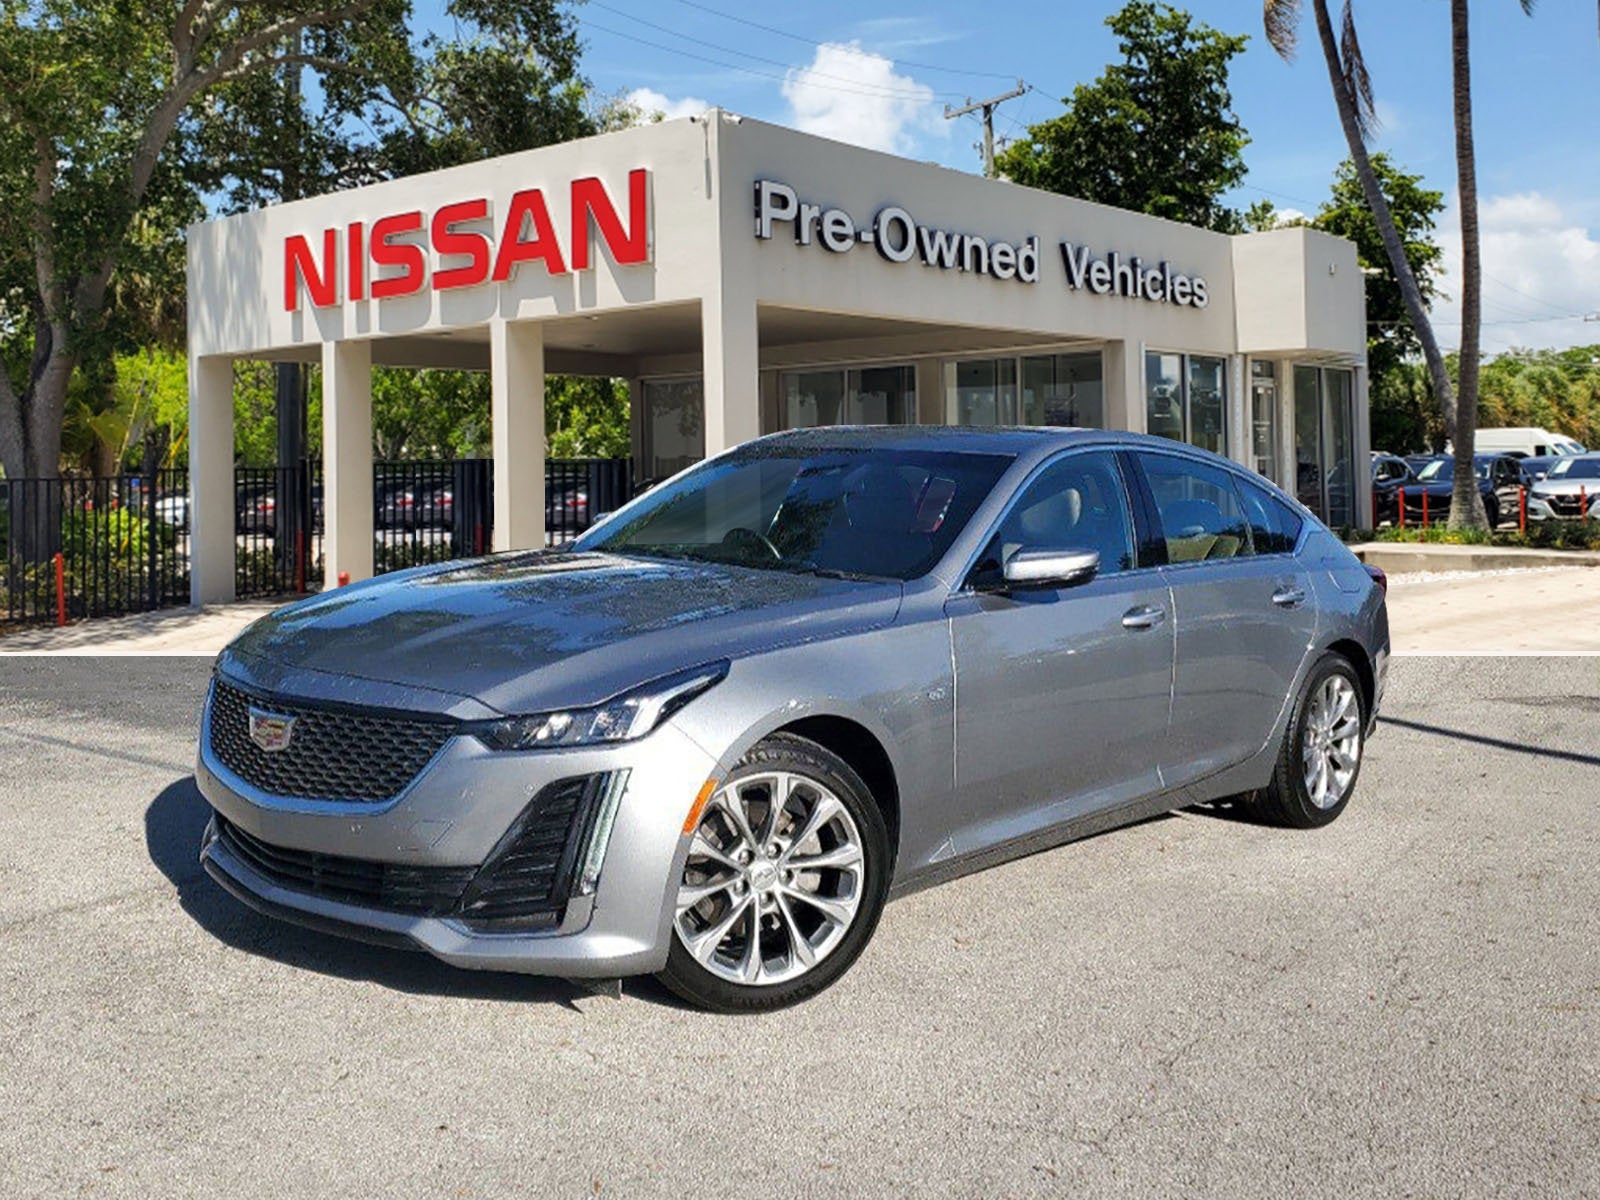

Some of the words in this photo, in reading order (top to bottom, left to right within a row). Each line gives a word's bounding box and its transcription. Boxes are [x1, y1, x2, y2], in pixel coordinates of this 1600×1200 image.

[284, 168, 647, 311] NISSAN
[755, 179, 1040, 284] Pre-Owned
[1061, 241, 1209, 309] Vehicles
